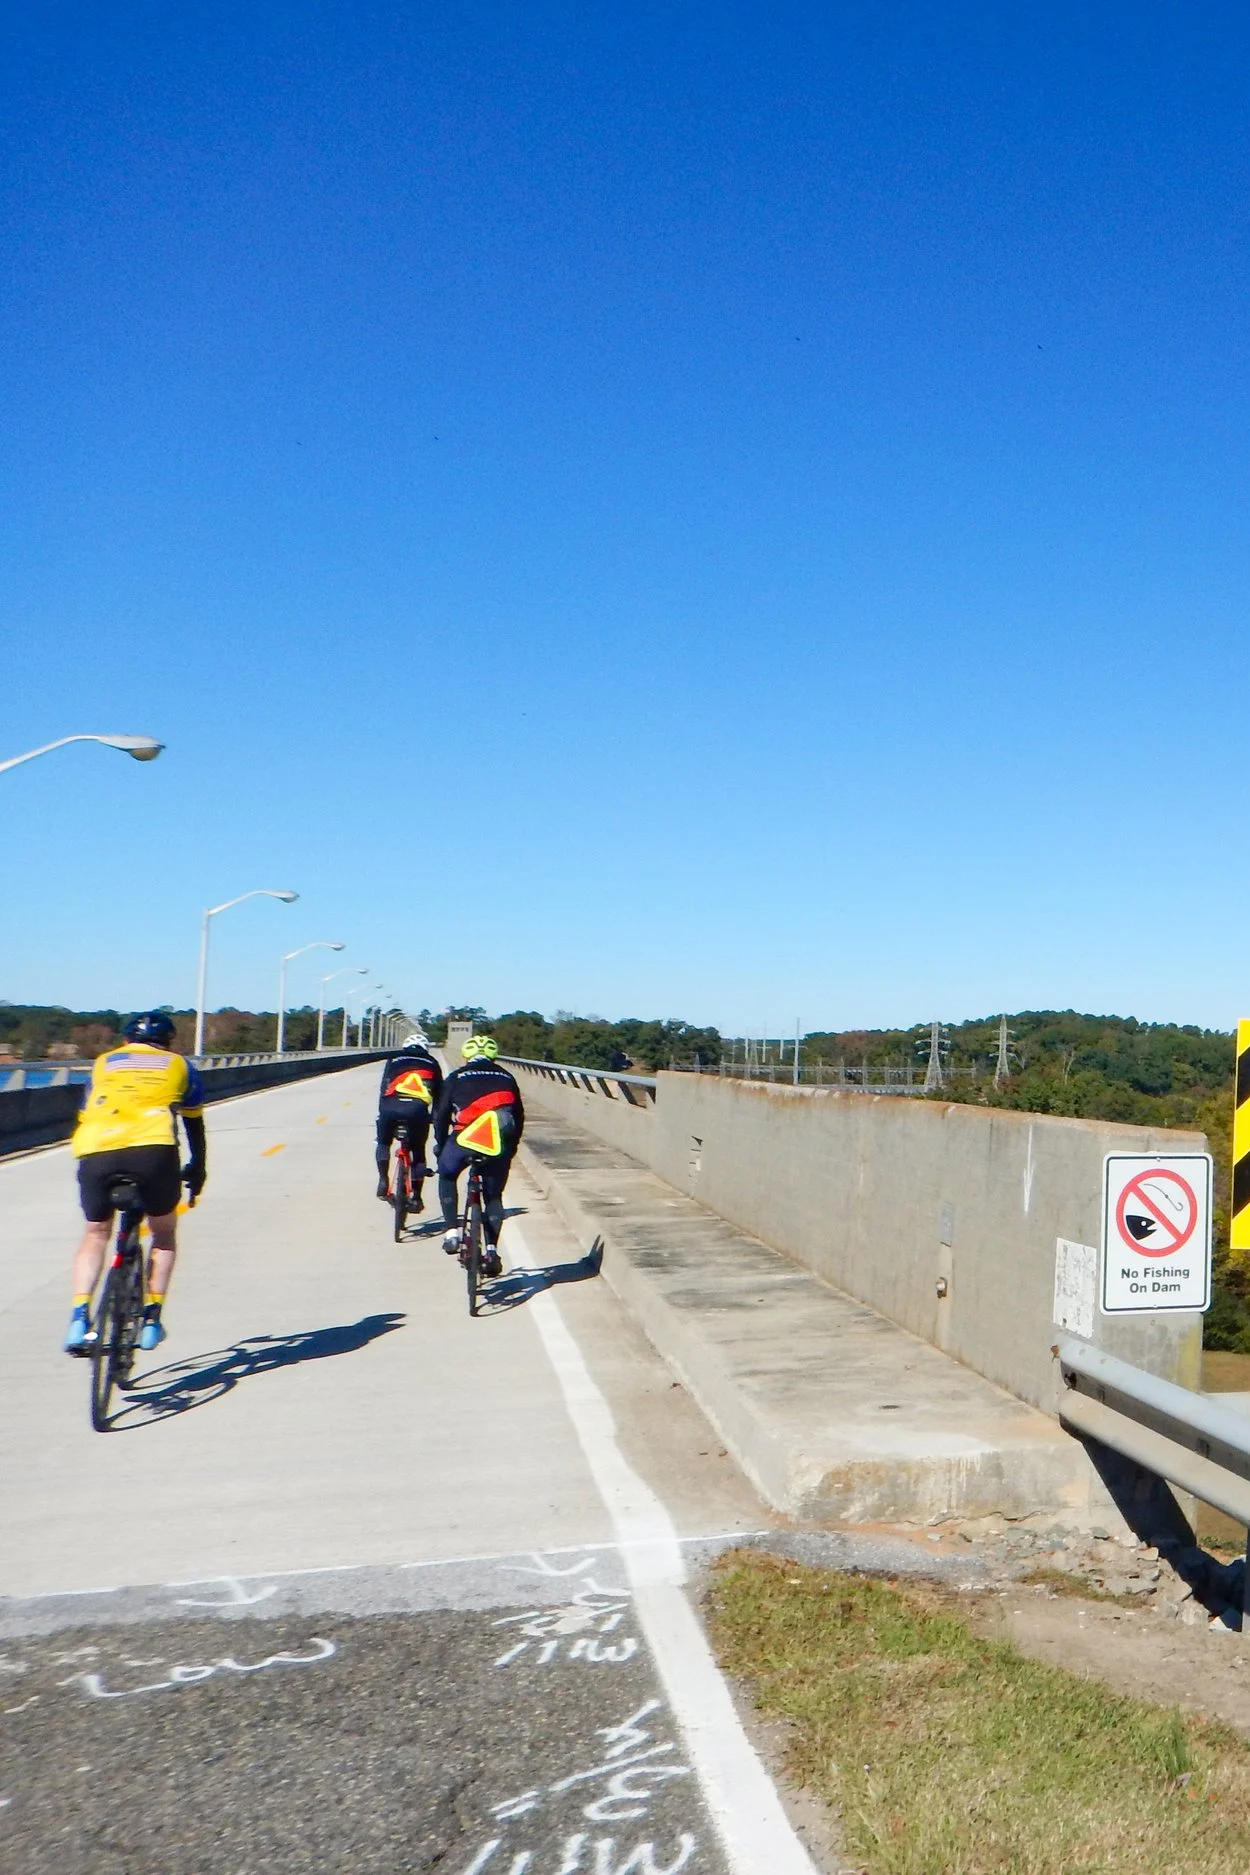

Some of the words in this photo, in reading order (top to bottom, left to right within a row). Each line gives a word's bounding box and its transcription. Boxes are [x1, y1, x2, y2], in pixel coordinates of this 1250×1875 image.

[1121, 1267, 1139, 1279] No
[1143, 1266, 1190, 1279] Fishing
[1129, 1282, 1147, 1294] On
[1151, 1281, 1181, 1293] Dam
